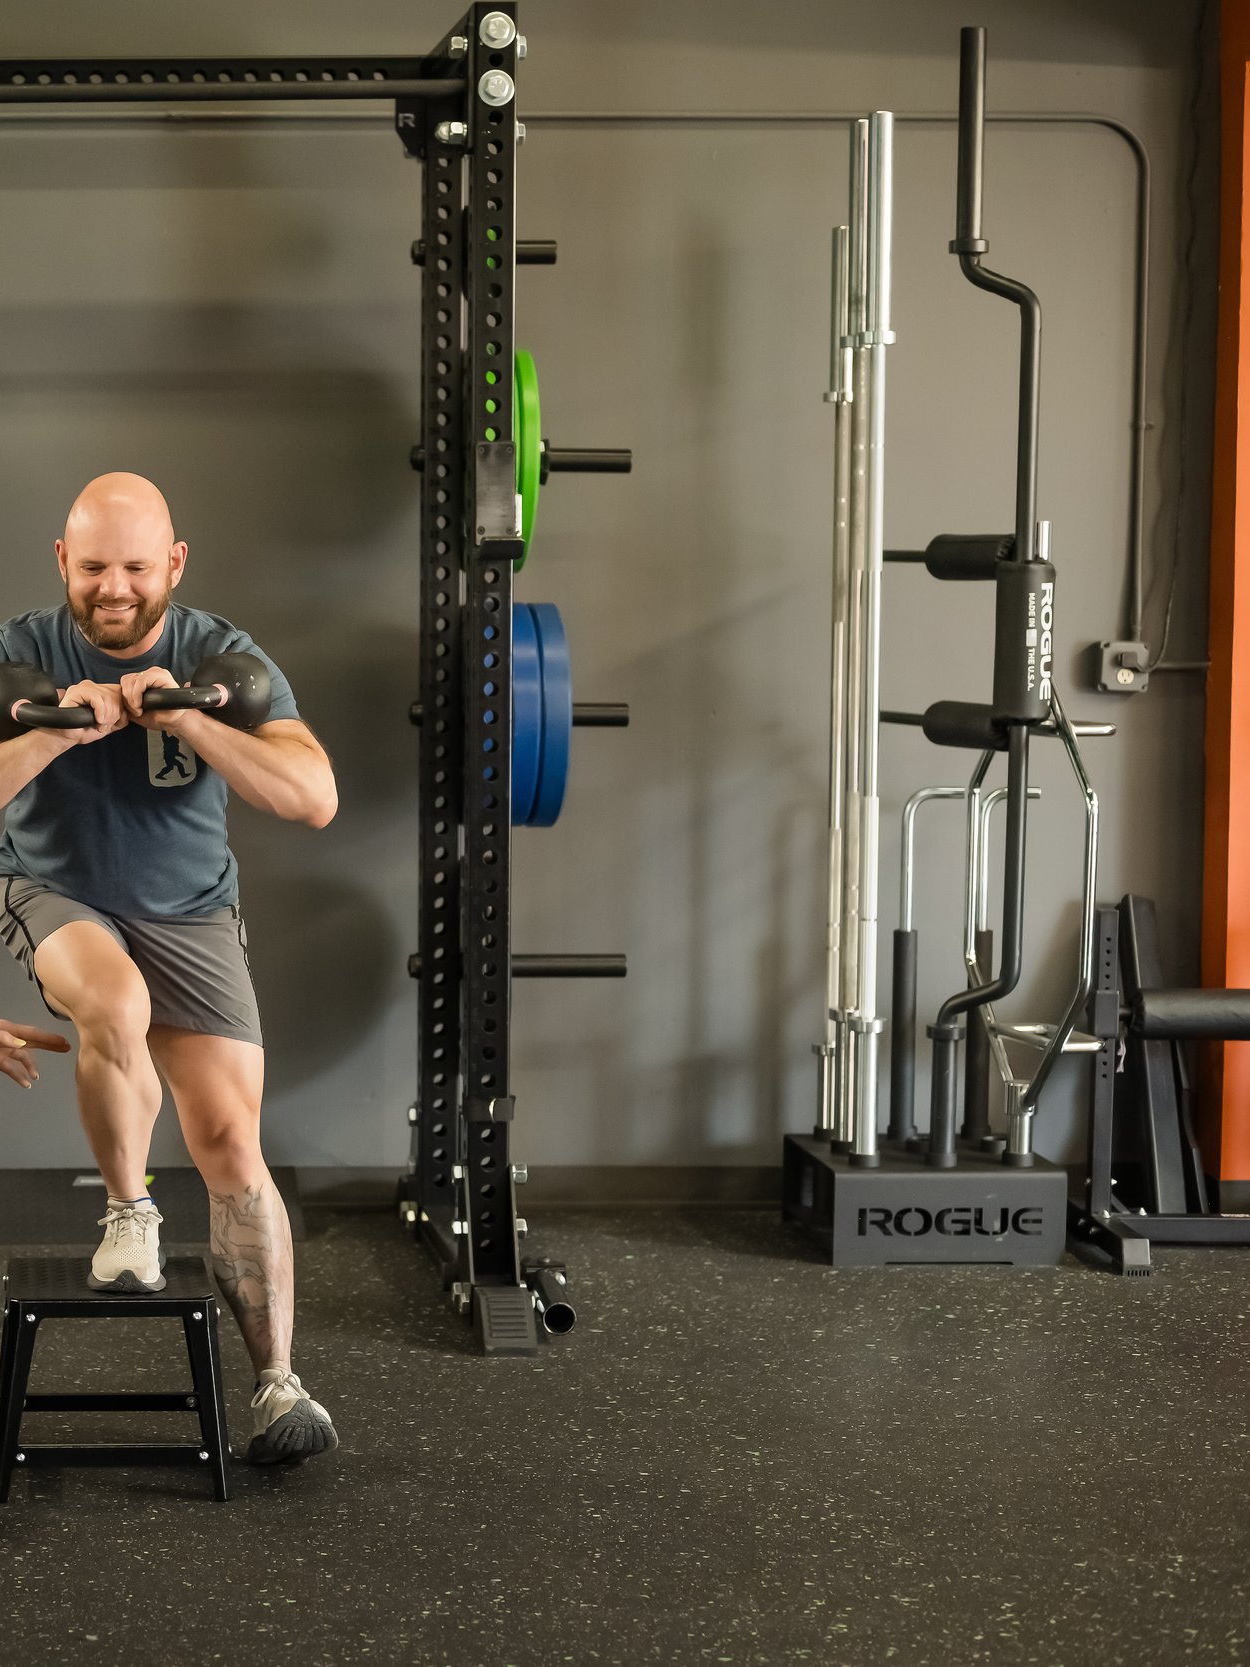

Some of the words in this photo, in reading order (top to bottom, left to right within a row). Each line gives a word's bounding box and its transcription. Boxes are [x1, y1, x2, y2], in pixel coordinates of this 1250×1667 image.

[398, 113, 416, 128] R
[1028, 592, 1036, 617] MADE
[1028, 617, 1036, 628] IN
[1039, 582, 1053, 700] ROGUE
[1027, 648, 1036, 665] THE
[857, 1207, 1043, 1236] ROGUE
